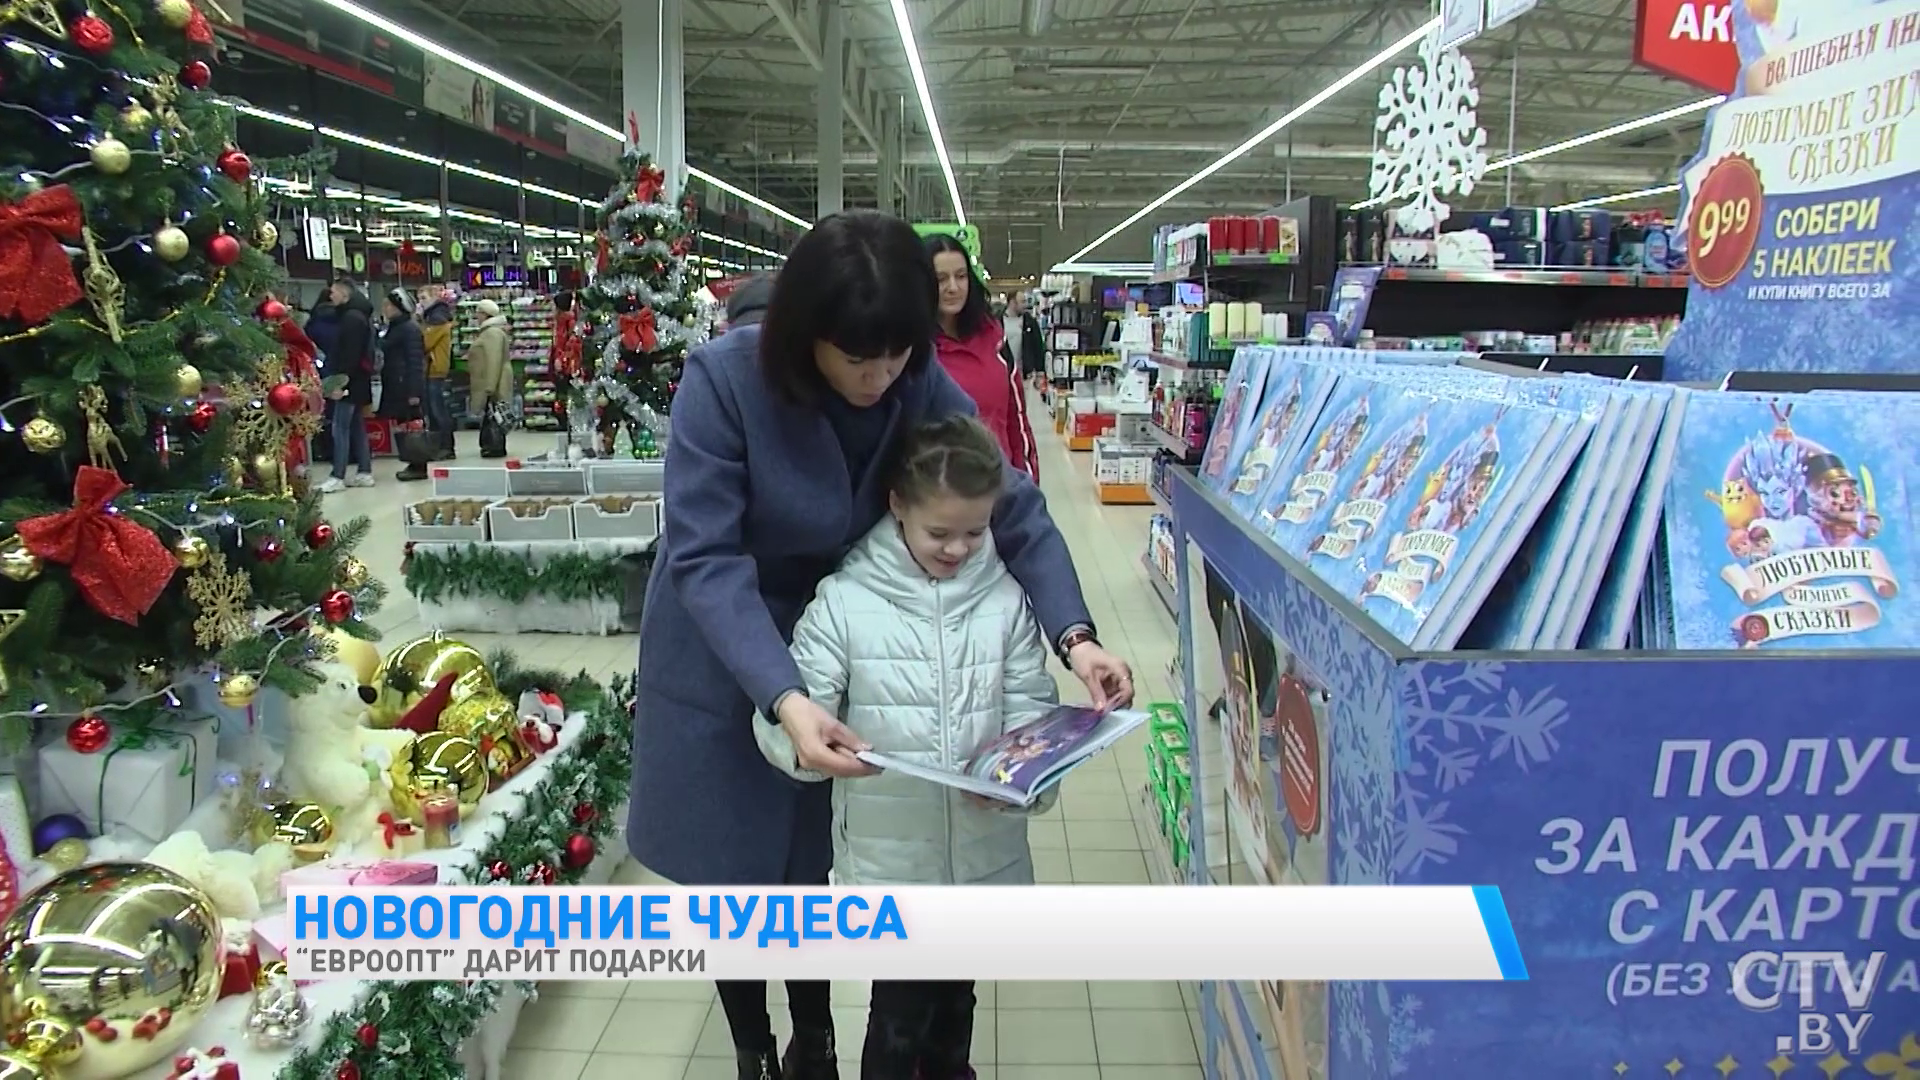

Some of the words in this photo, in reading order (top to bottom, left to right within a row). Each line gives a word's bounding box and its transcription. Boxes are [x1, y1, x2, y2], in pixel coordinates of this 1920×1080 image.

[1669, 2, 1737, 42] АК
[1764, 20, 1882, 88] ВОЛШЕБНАЯ
[1725, 90, 1856, 150] ЛЮБИМЫЕ
[1788, 123, 1899, 185] СКАЗКИ
[1775, 196, 1882, 239] СОБЕРИ
[1752, 249, 1768, 279] 5
[1771, 238, 1897, 278] НАКЛЕЕК
[1748, 285, 1756, 300] И
[1757, 285, 1787, 300] КУПИ
[1788, 284, 1827, 301] КНИГУ
[1827, 283, 1869, 299] ВСЕГО
[1871, 283, 1890, 298] ЗА
[1755, 549, 1873, 588] ЛЮБИМЫЕ
[1788, 587, 1852, 603] ЗИМНИЕ
[1773, 608, 1852, 632] СКАЗКИ
[1534, 816, 1638, 875] ЗА
[1666, 813, 1920, 882] КАЖД
[1607, 889, 1660, 945] С
[1606, 961, 1711, 1007] (БЕЗ
